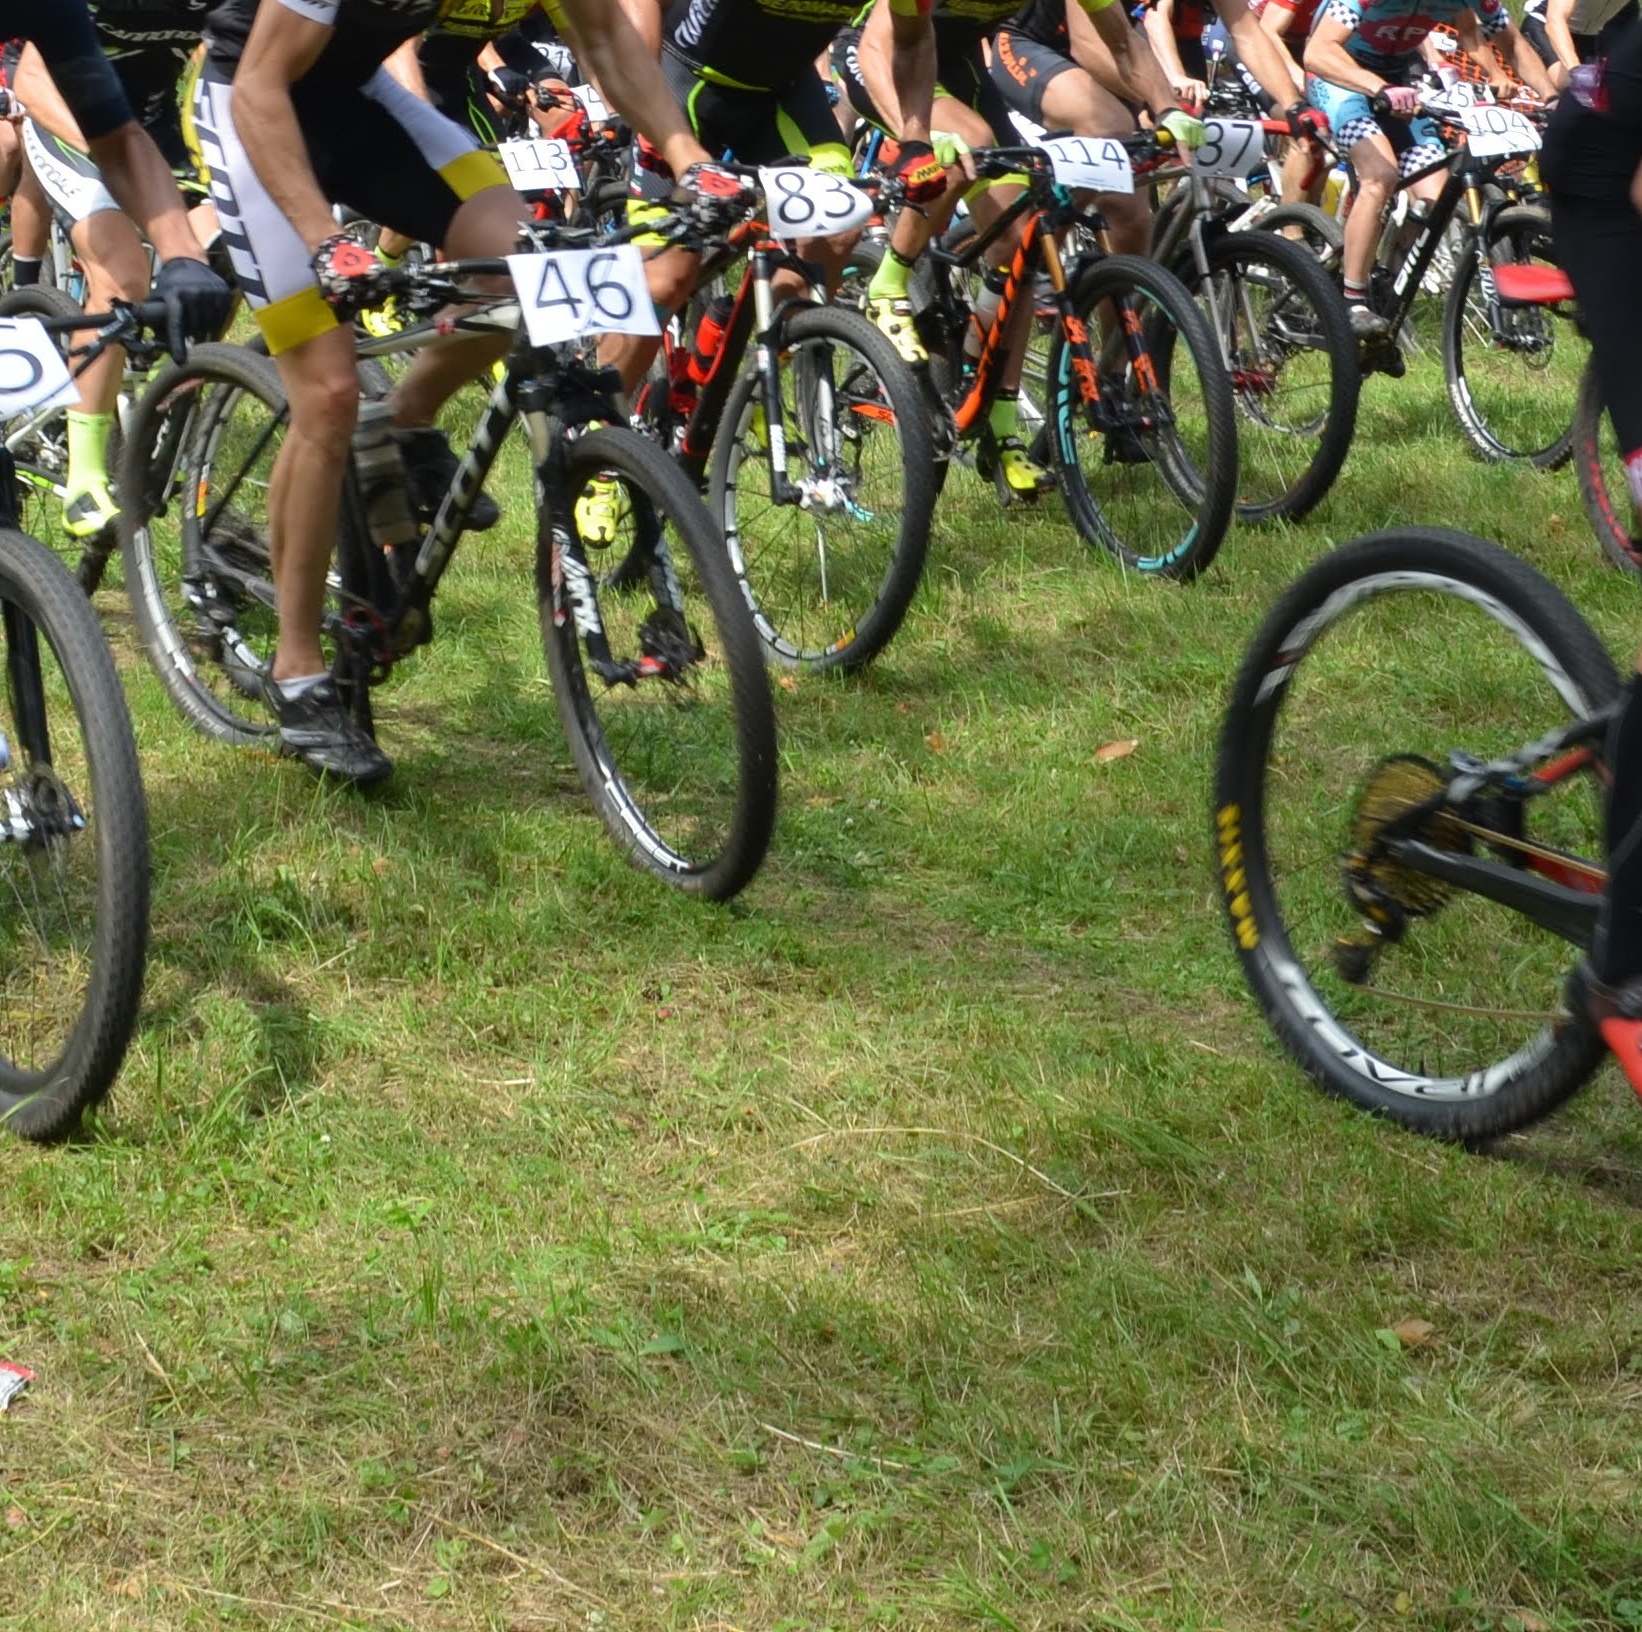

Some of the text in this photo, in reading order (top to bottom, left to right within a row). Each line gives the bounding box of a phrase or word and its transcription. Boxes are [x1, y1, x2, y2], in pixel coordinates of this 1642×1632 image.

[1374, 24, 1426, 41] RP
[1469, 108, 1530, 137] 104
[508, 142, 568, 172] 113
[1049, 139, 1126, 171] 114
[775, 170, 857, 226] 83
[534, 253, 635, 320] 46
